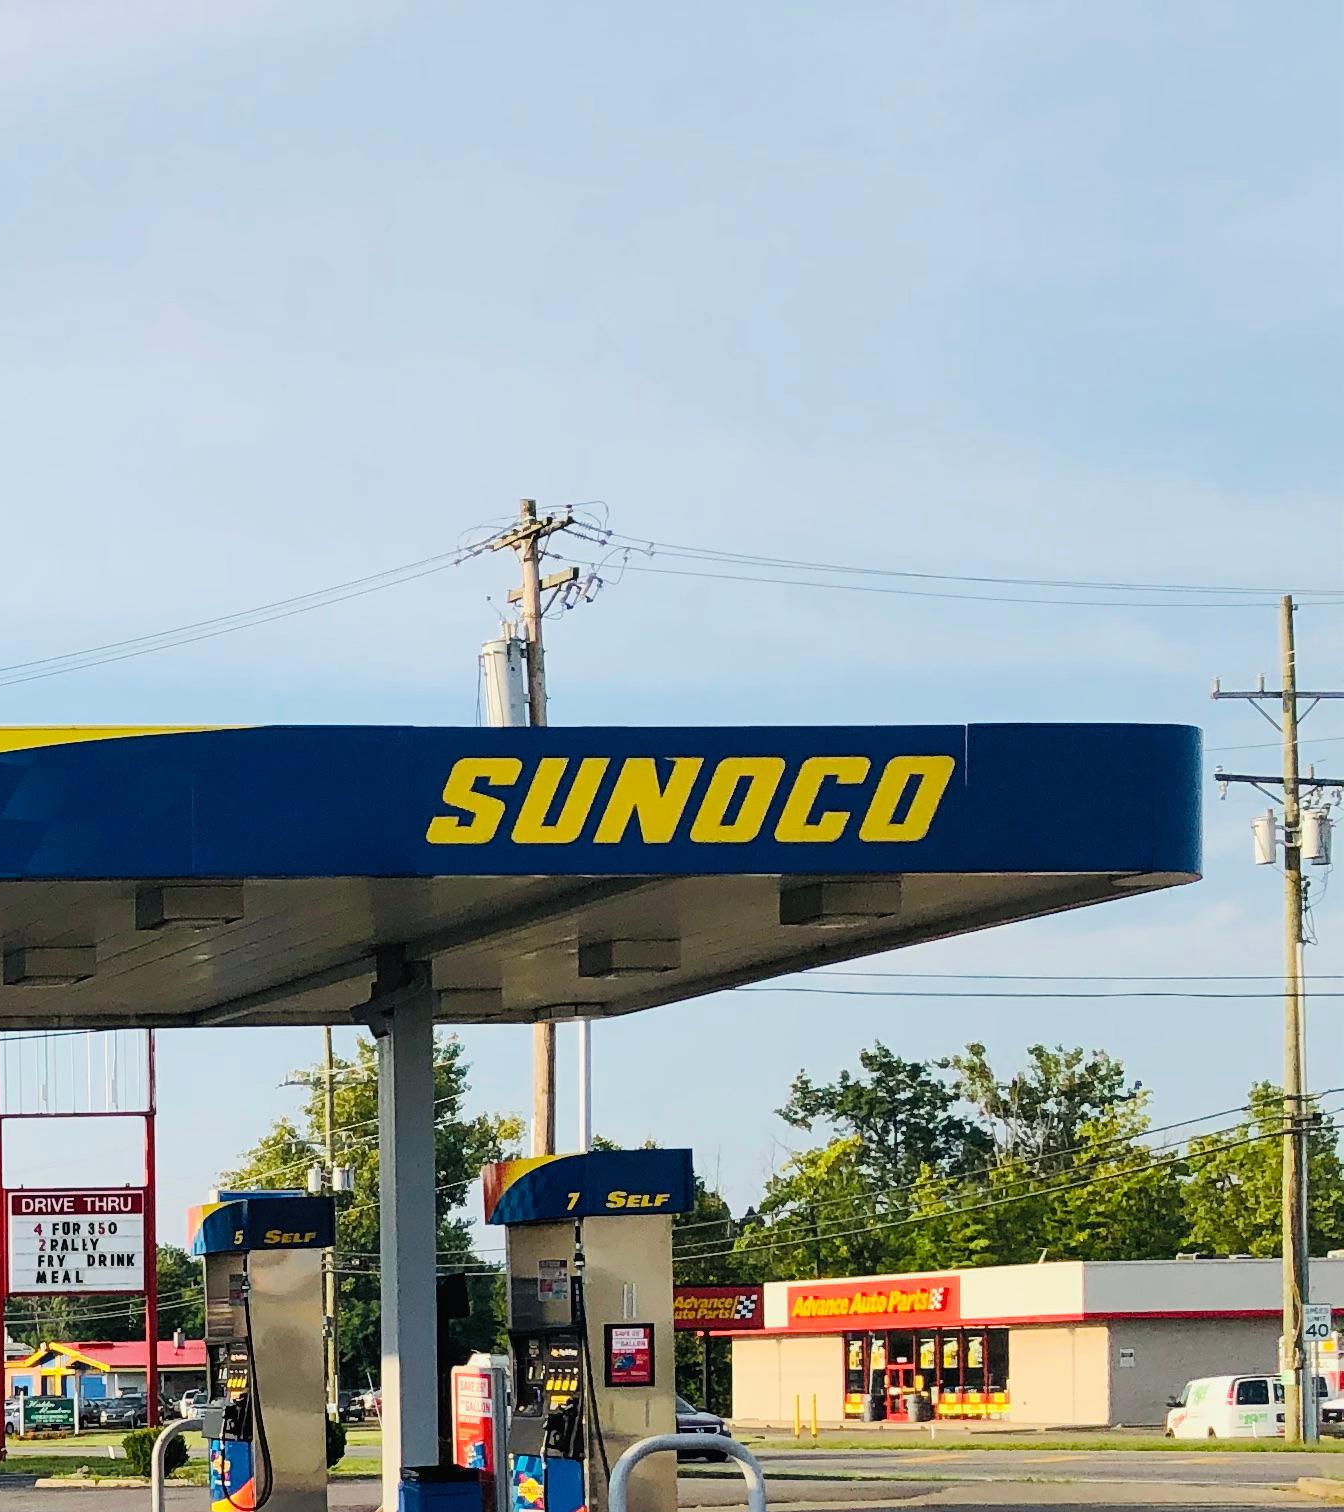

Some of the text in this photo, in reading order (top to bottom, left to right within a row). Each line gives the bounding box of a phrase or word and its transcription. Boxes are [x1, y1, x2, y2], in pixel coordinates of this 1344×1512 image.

[426, 755, 956, 845] SUNOCO
[21, 1196, 132, 1213] DRIVE THRU
[566, 1191, 581, 1211] 7
[605, 1190, 671, 1209] SELF
[33, 1222, 118, 1236] 4 FOR 350
[233, 1229, 244, 1245] 5
[38, 1238, 99, 1252] 2 RALLY
[37, 1254, 135, 1268] FRY DRINK
[35, 1270, 84, 1284] MEAL
[673, 1294, 734, 1310] Advance
[791, 1288, 930, 1318] Advance Auto Parts
[674, 1308, 732, 1320] uto Parts
[1305, 1323, 1329, 1337] 40
